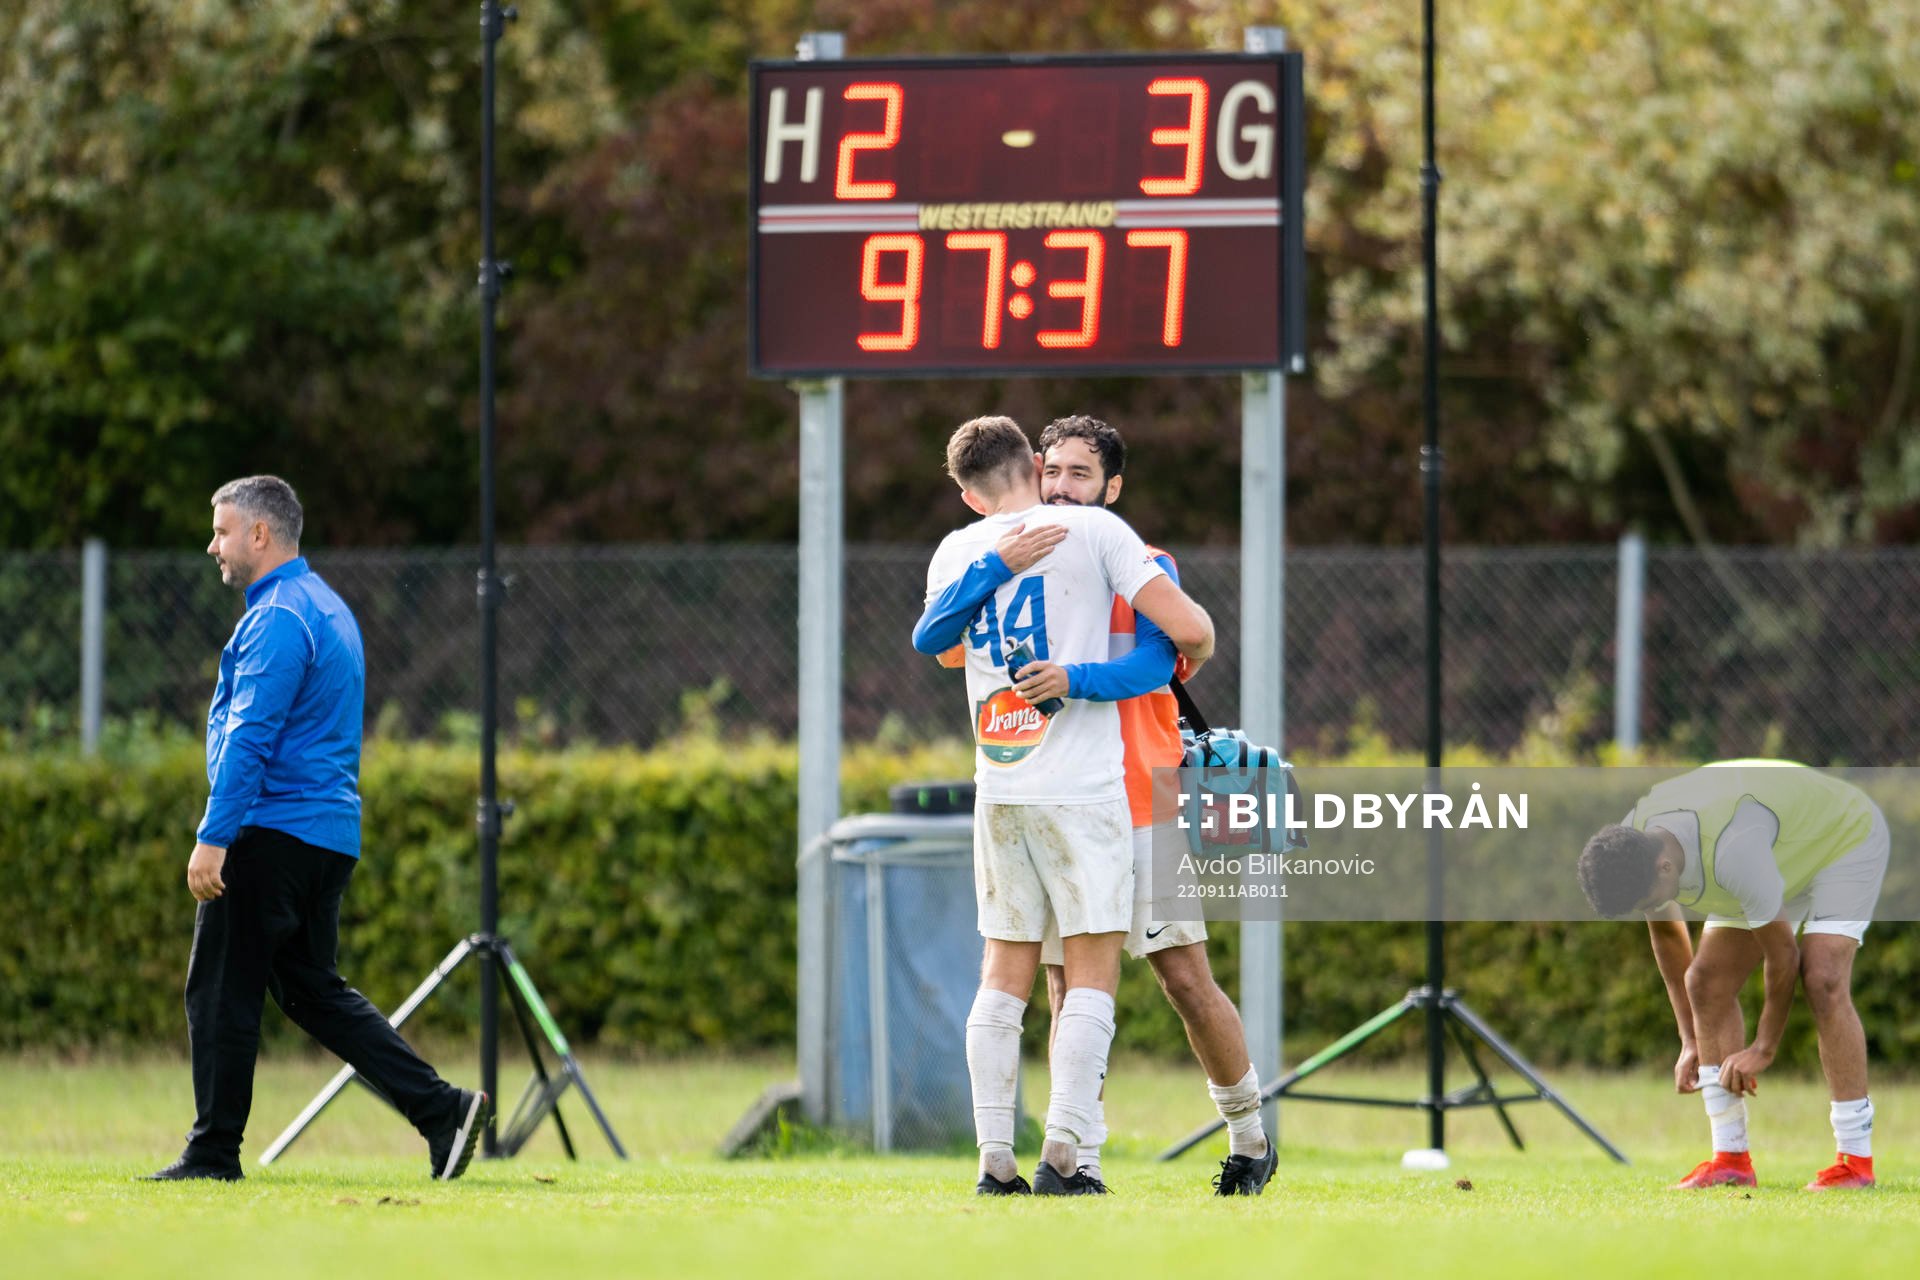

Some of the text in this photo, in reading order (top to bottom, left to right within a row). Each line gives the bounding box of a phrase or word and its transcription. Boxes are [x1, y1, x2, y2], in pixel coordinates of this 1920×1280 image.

[763, 87, 823, 184] H
[835, 82, 903, 199] 2
[1140, 77, 1209, 196] 3
[1216, 80, 1276, 180] G
[918, 202, 1116, 230] WESTERSTRAND
[857, 230, 1189, 351] 97:37
[968, 576, 1049, 667] 44
